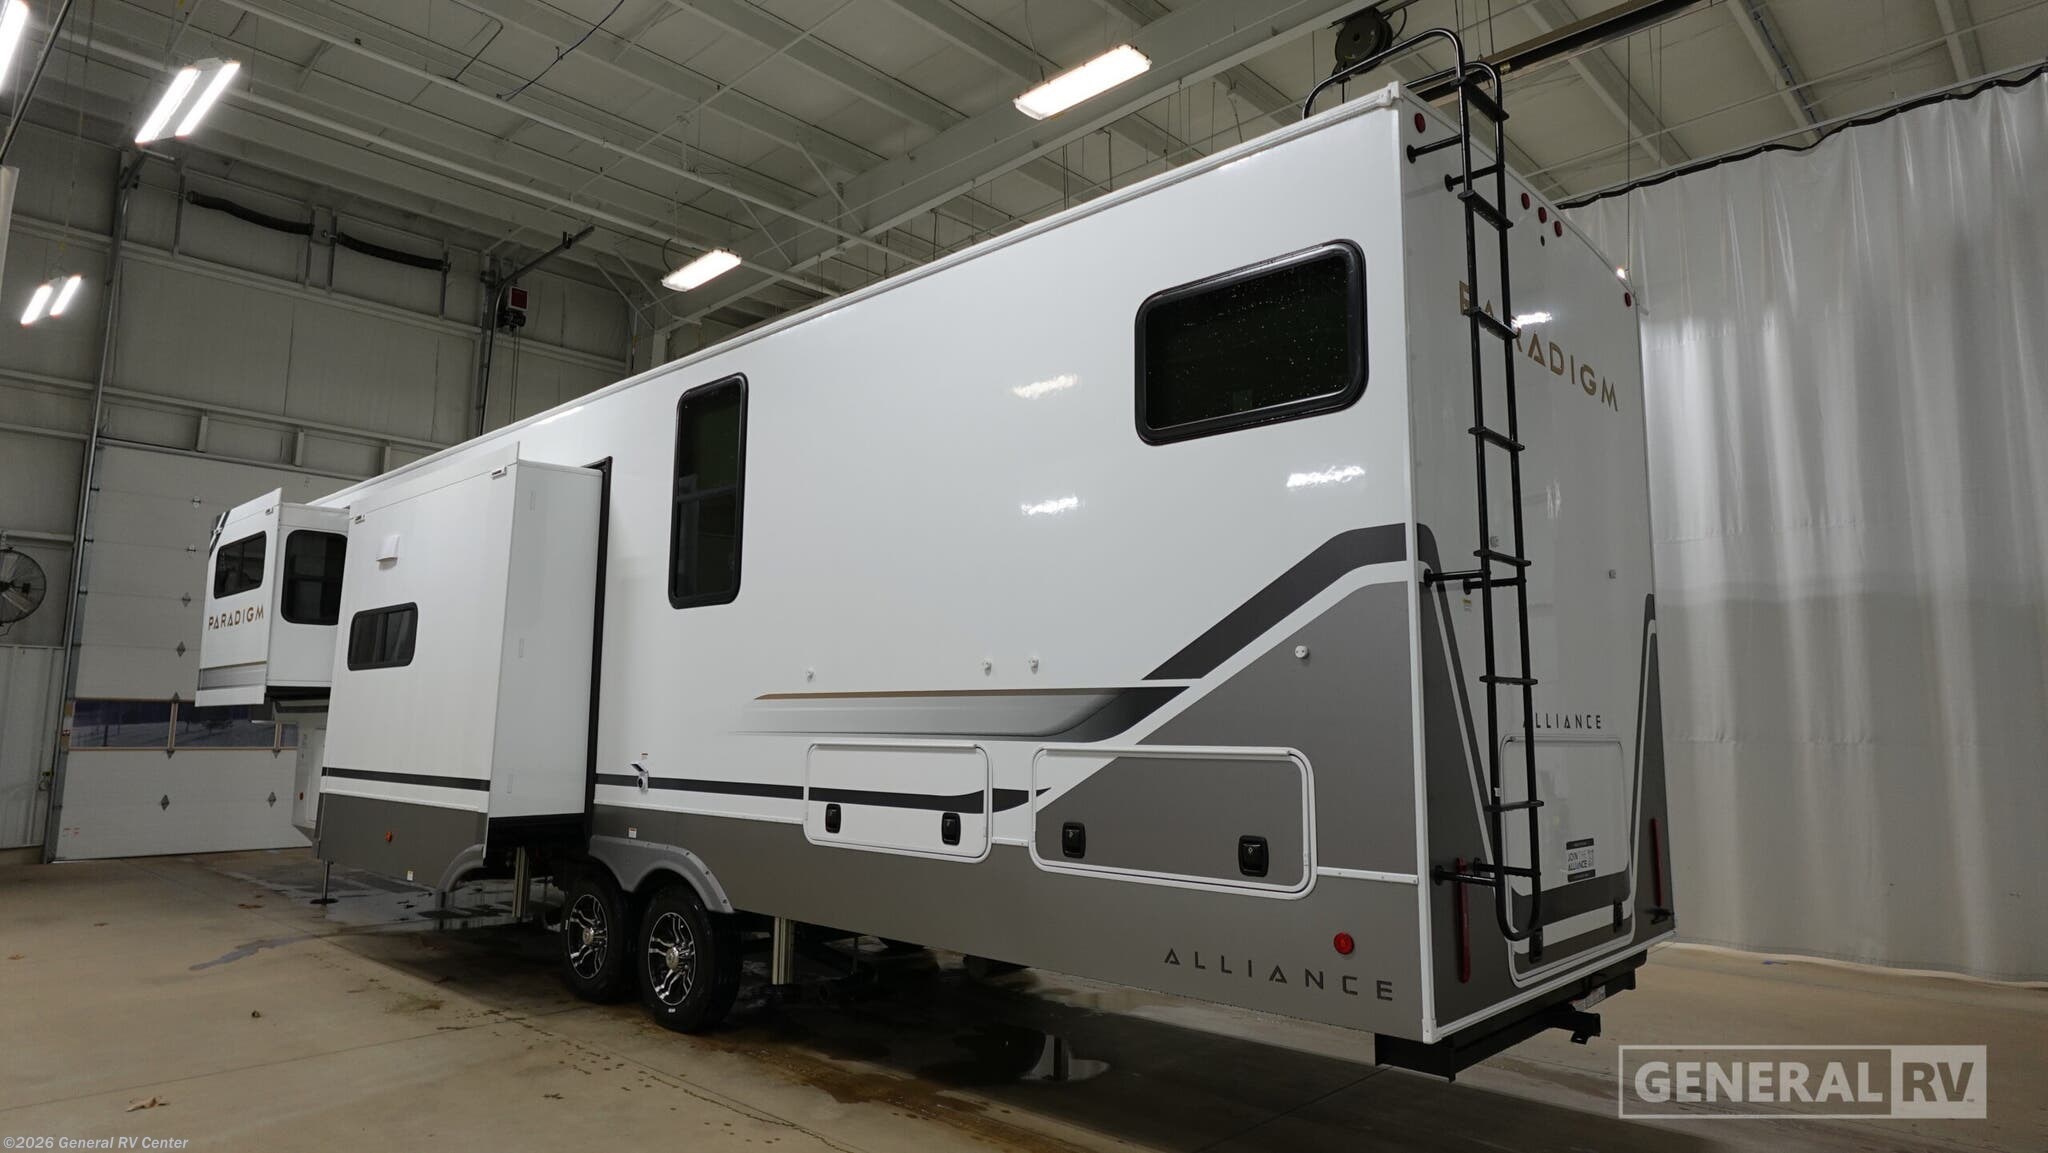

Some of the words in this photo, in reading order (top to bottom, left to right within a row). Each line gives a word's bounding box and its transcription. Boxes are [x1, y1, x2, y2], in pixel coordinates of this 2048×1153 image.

[208, 605, 264, 630] PARADIGM
[1523, 712, 1601, 729] LLIANCE
[1164, 948, 1393, 1001] ALLIANCE
